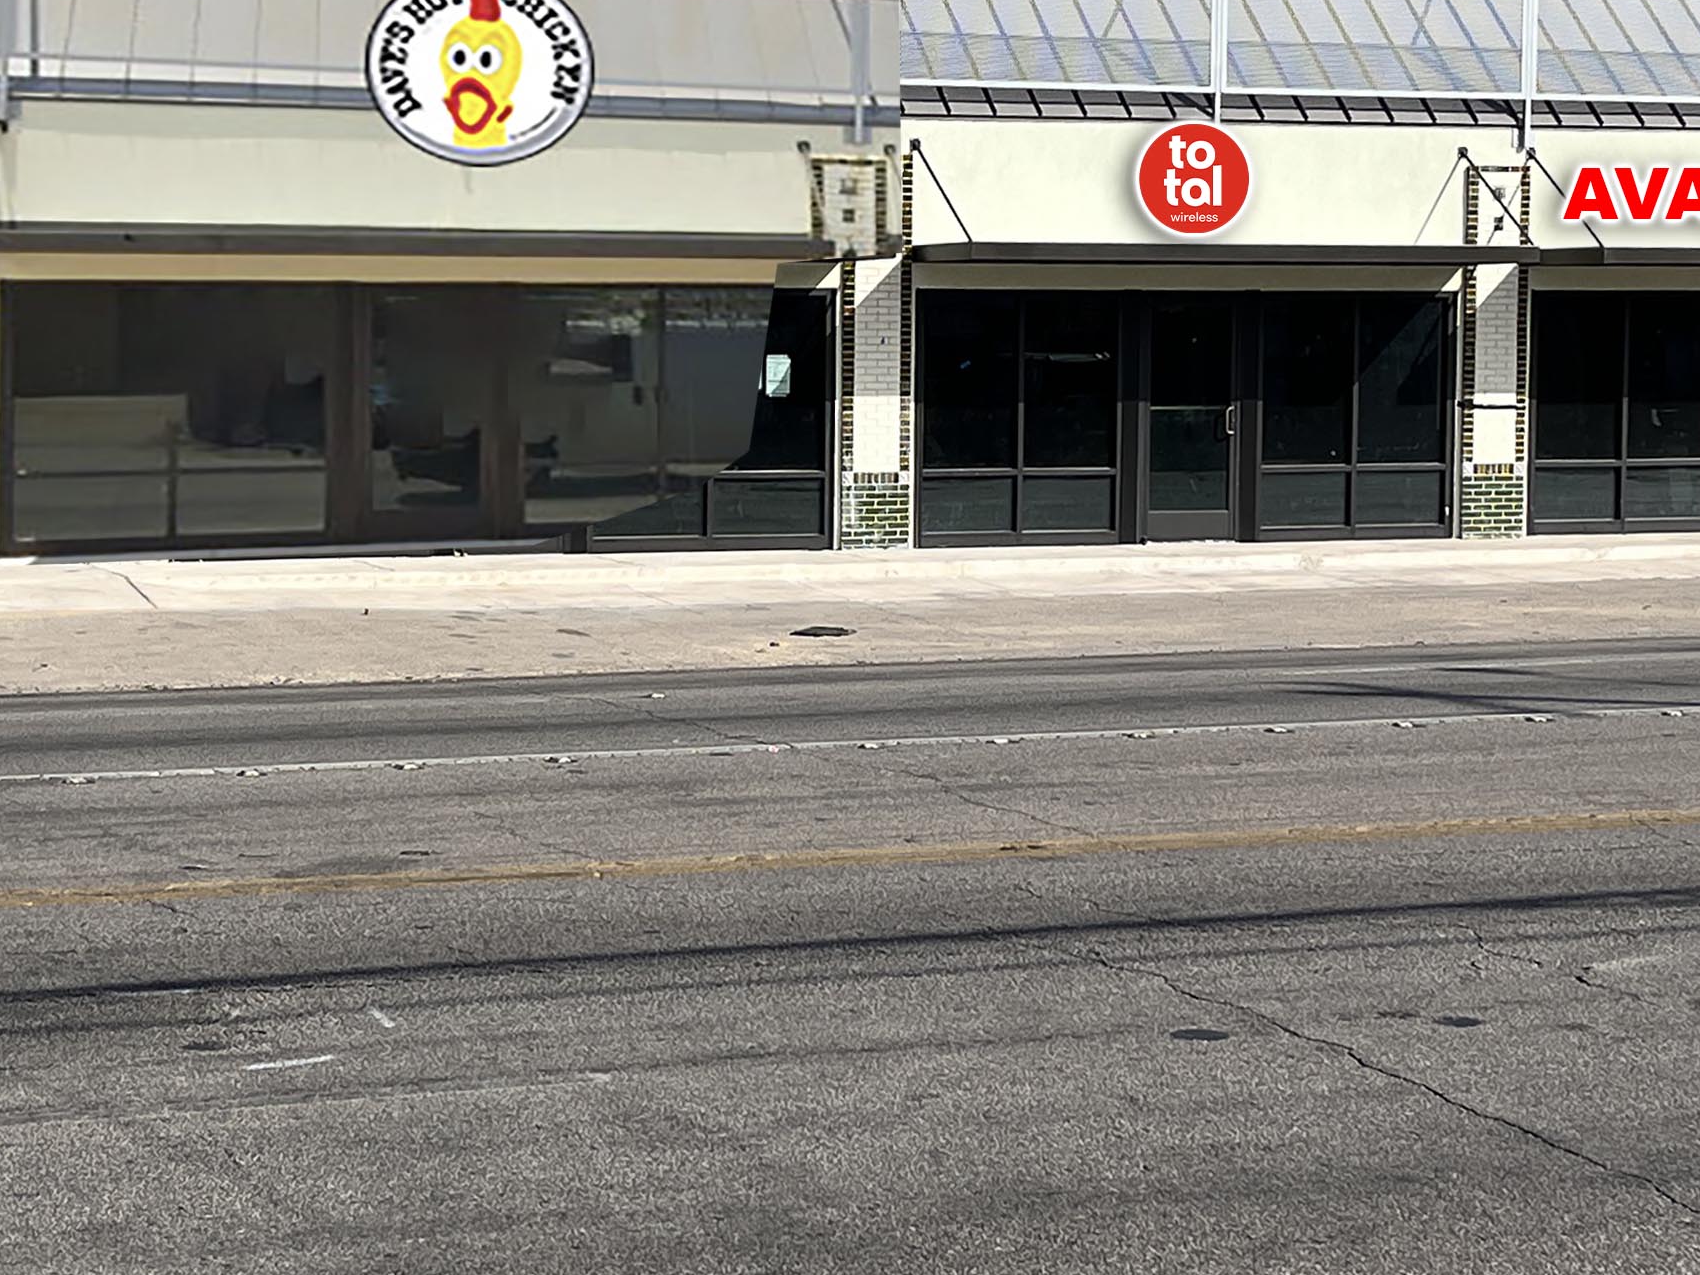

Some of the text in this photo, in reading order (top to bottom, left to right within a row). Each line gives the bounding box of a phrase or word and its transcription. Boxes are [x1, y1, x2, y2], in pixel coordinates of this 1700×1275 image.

[379, 21, 422, 117] DAVE'S
[1168, 135, 1216, 170] to
[1170, 211, 1219, 223] wireless
